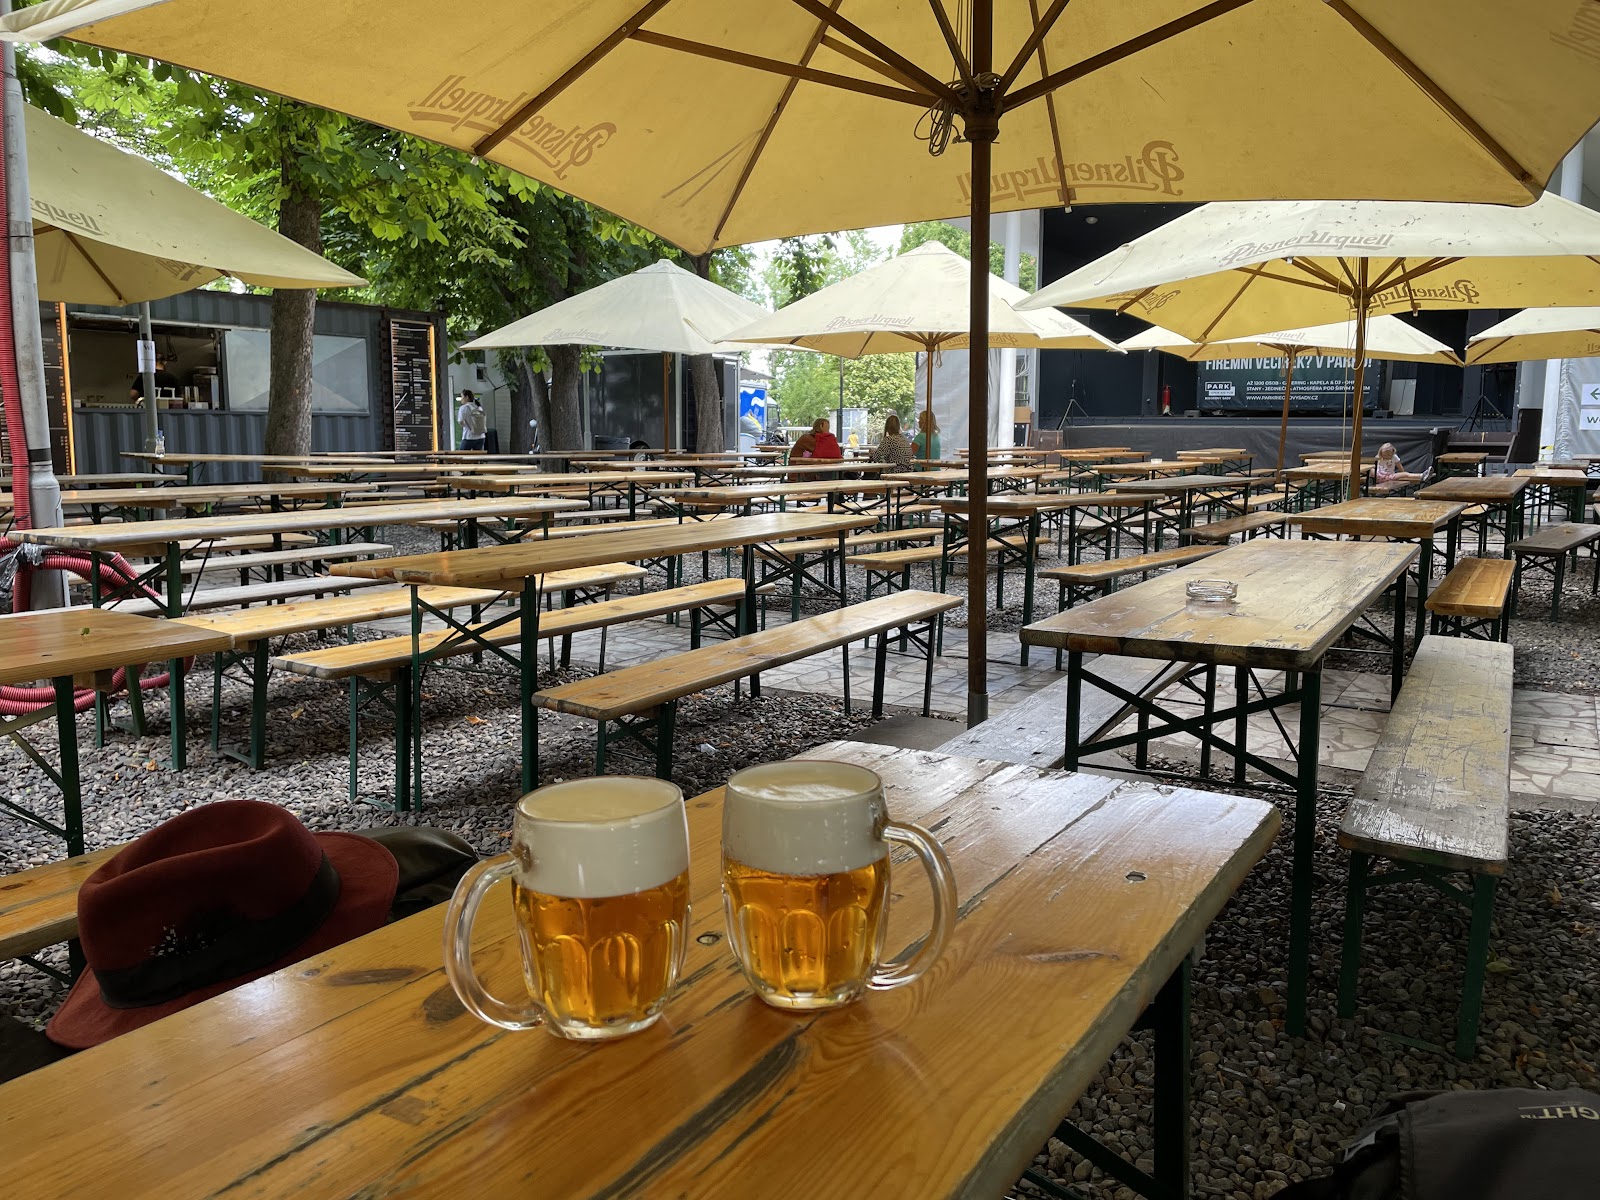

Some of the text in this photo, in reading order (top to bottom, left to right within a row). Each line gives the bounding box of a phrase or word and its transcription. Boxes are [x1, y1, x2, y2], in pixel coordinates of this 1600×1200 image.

[1218, 230, 1394, 267] Pilsner Urquell
[1316, 355, 1324, 369] V
